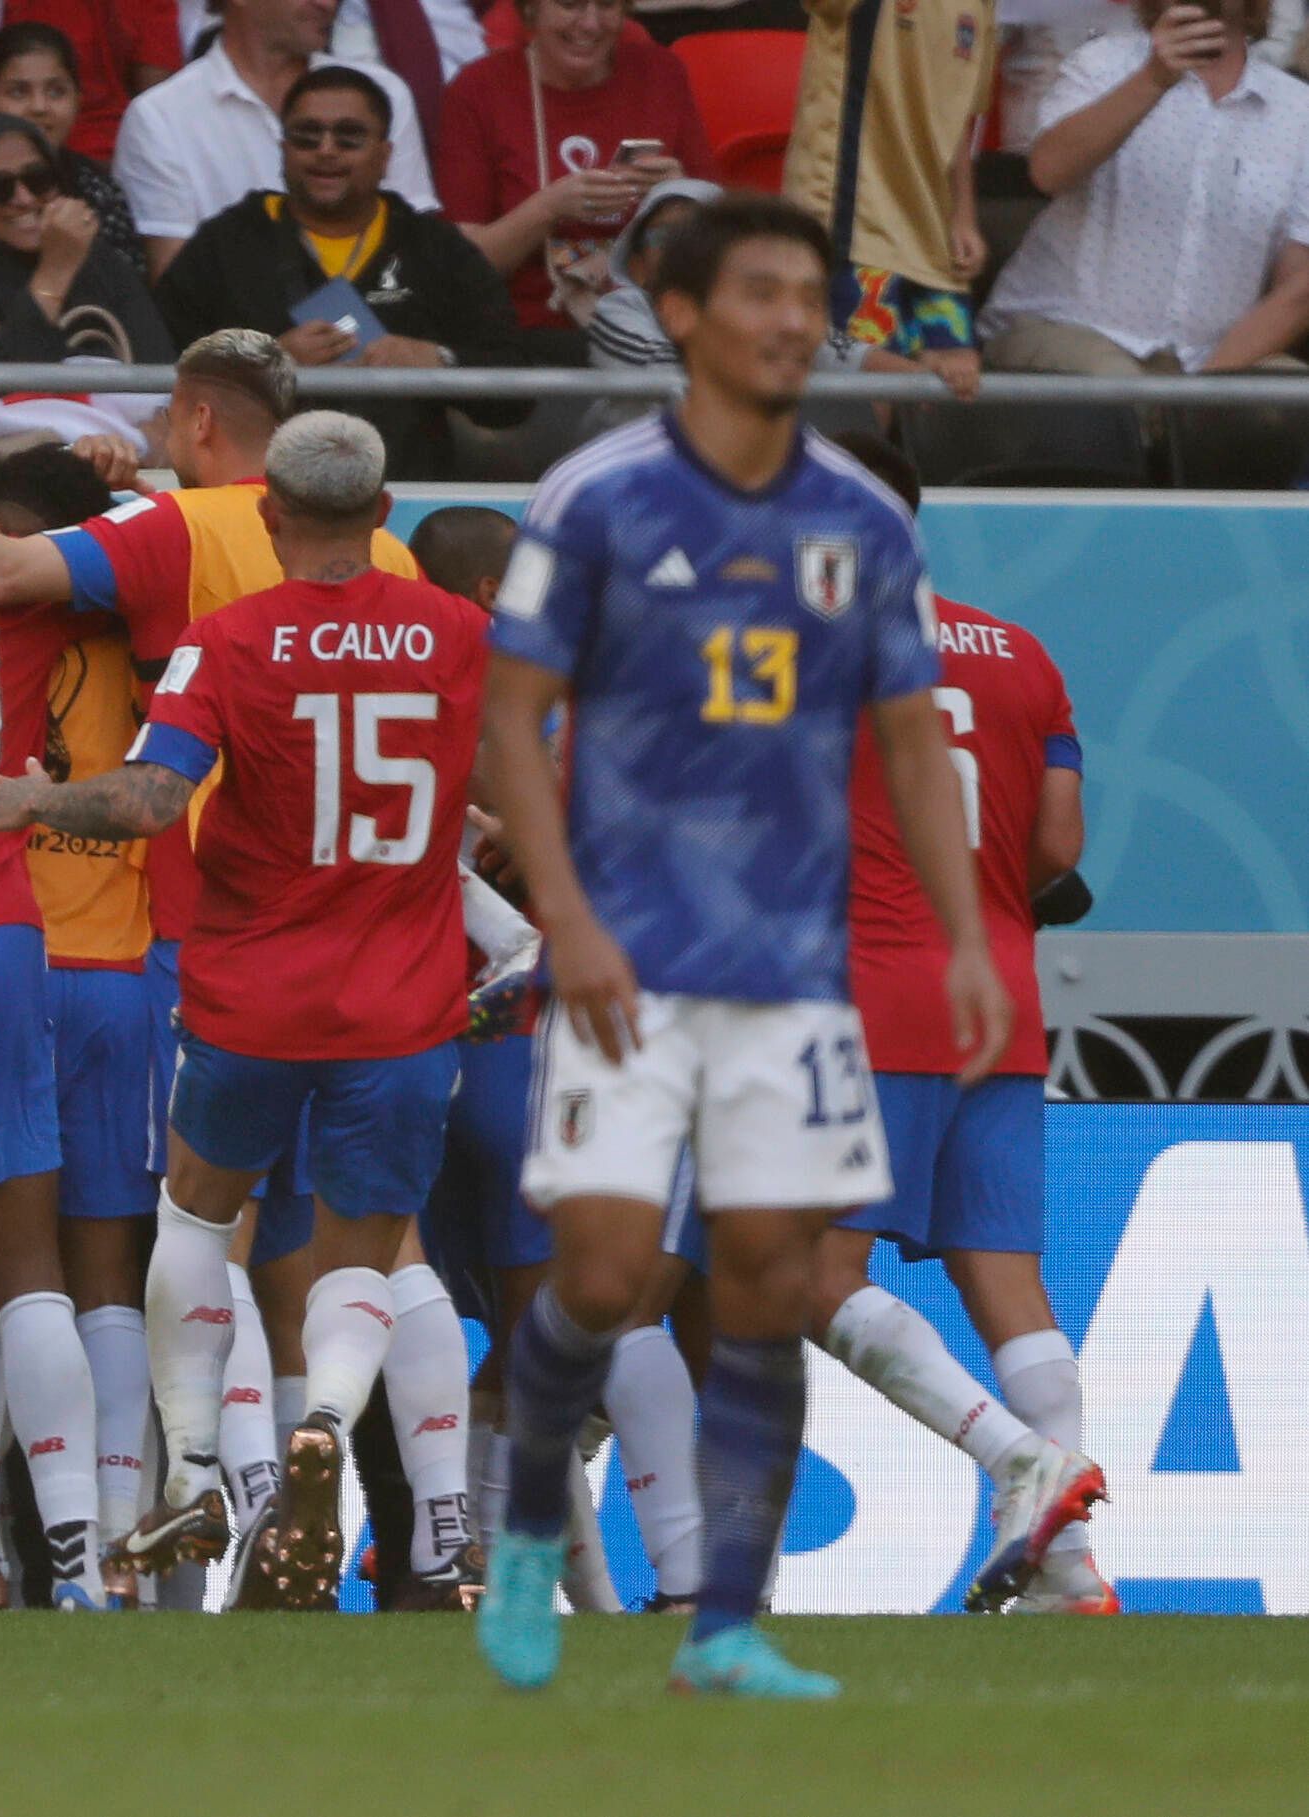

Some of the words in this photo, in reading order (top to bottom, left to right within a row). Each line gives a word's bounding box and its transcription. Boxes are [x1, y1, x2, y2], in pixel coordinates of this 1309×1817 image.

[271, 625, 299, 662] F.
[309, 622, 435, 661] CALVO
[938, 622, 1015, 659] ARTE
[699, 626, 800, 725] 13
[292, 692, 438, 867] 15
